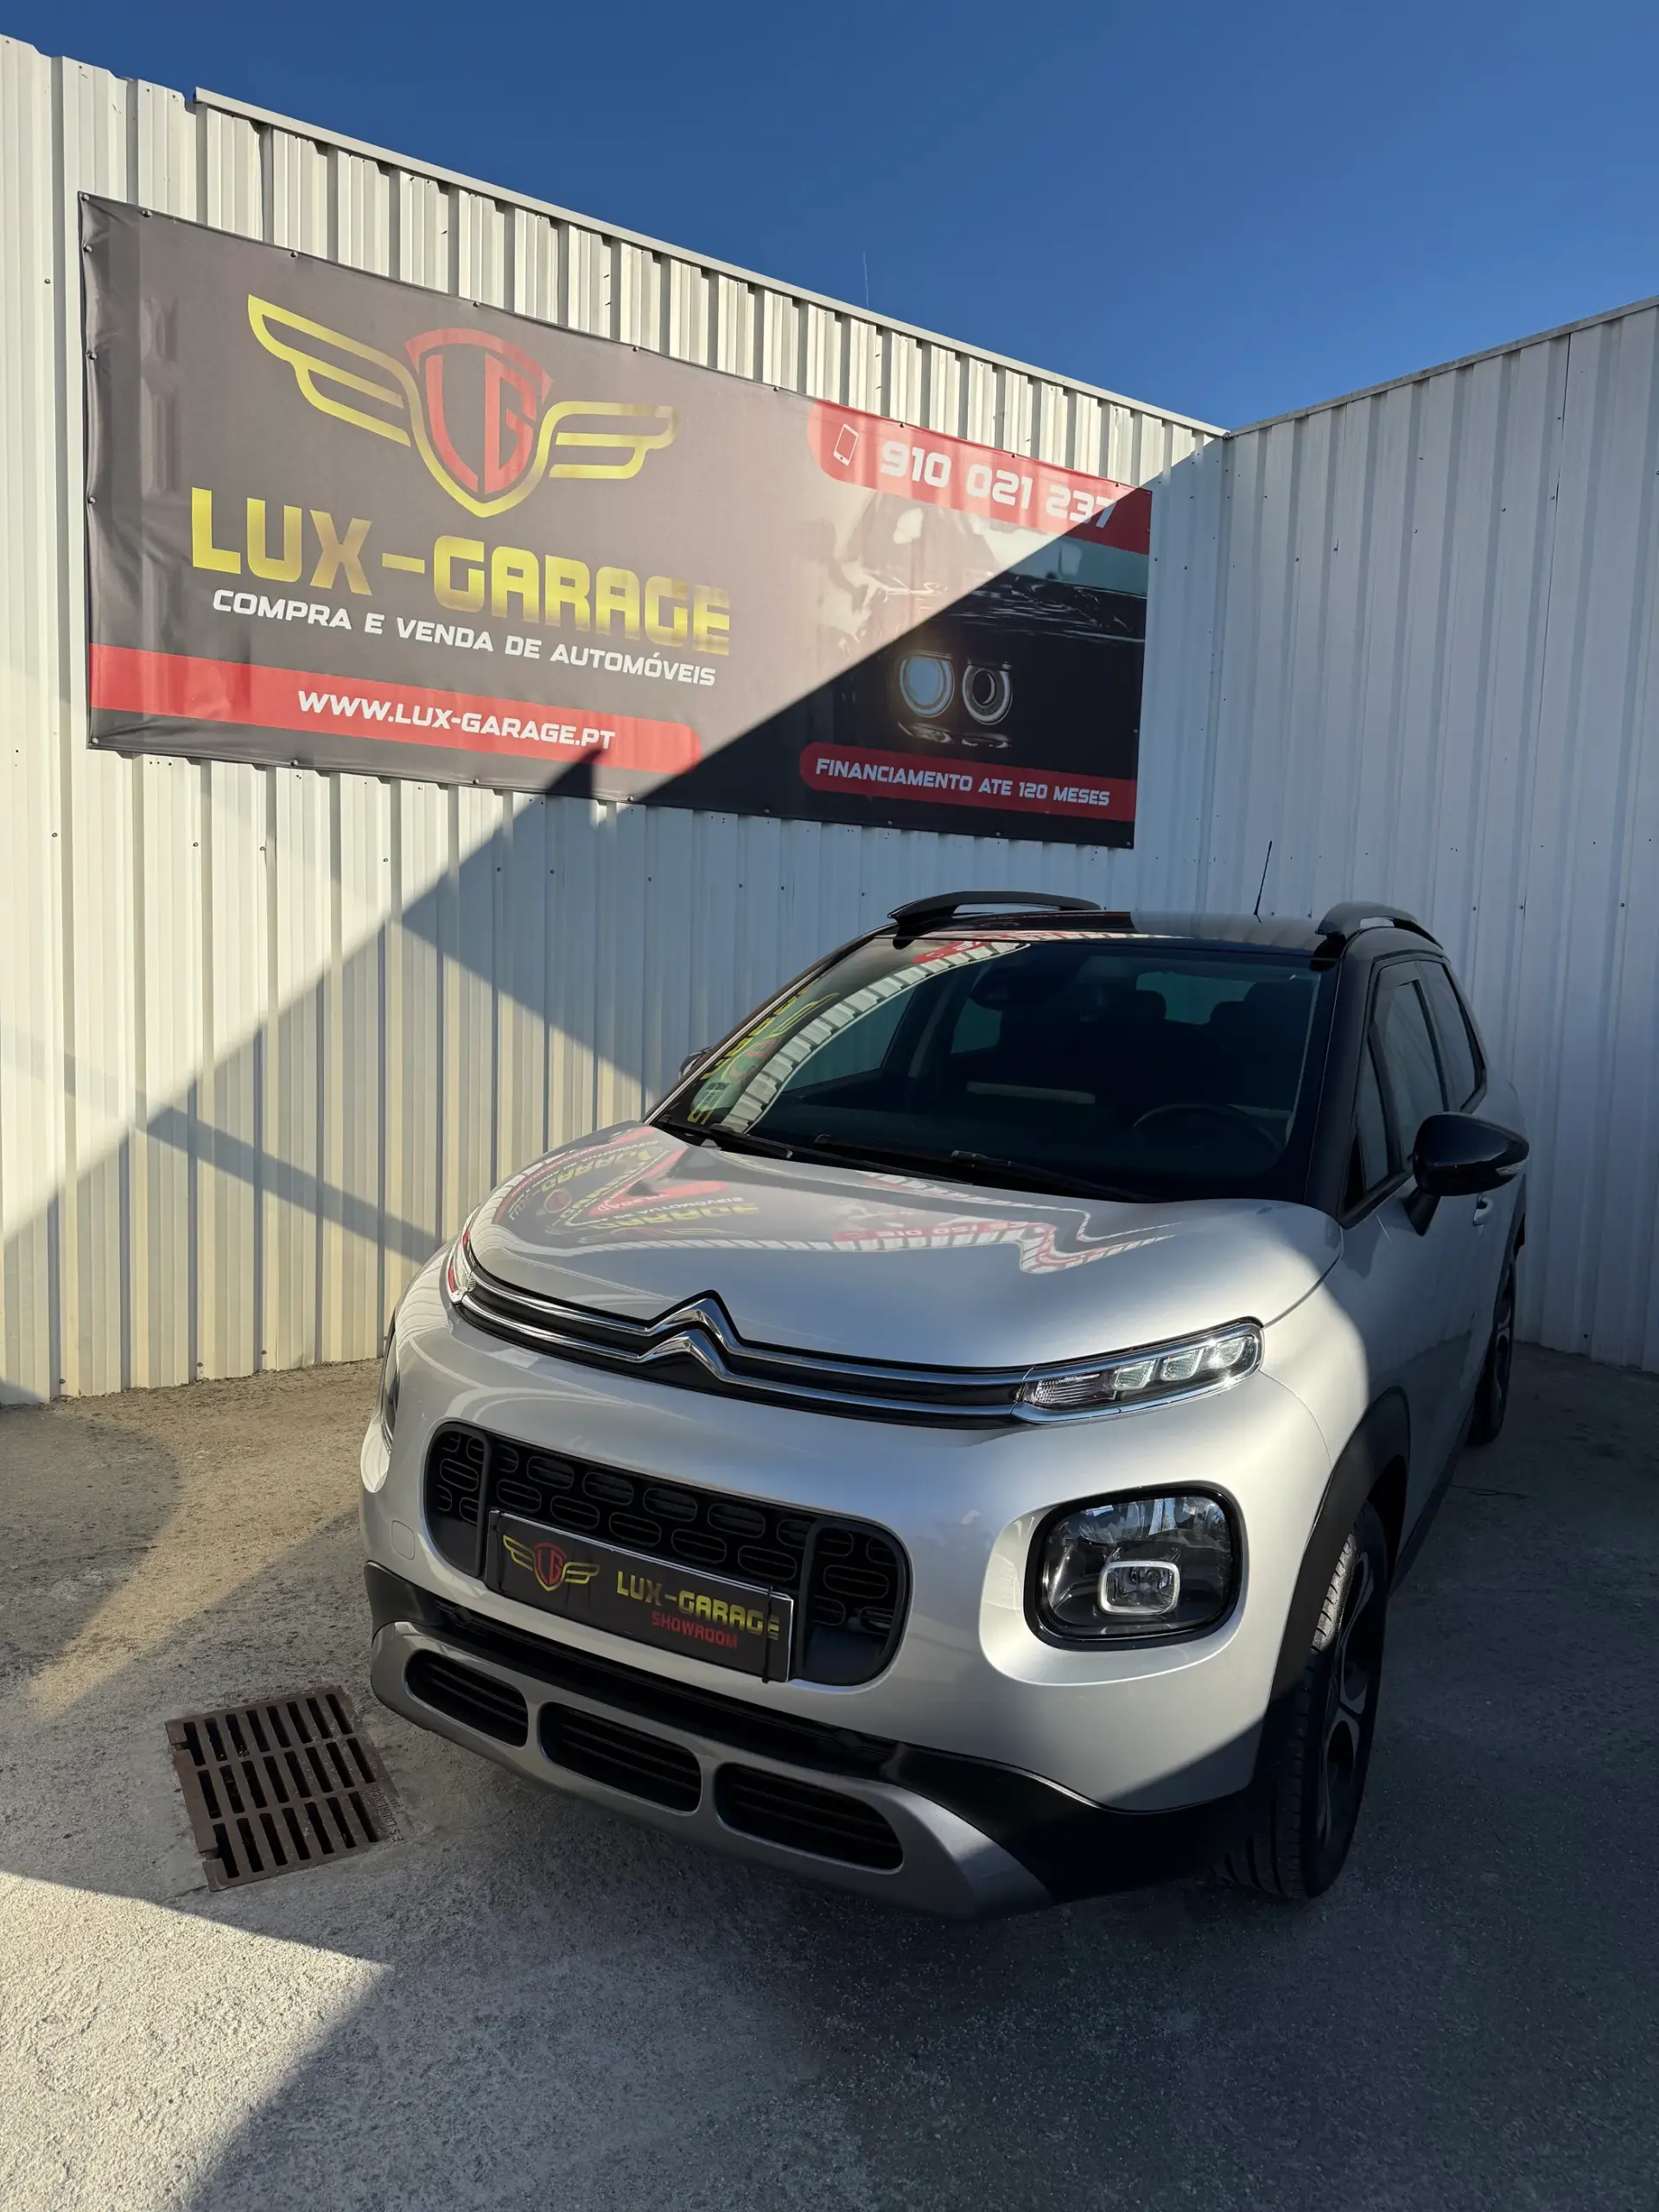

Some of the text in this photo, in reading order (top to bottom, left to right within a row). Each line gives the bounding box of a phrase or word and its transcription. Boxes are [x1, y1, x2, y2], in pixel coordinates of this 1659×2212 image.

[880, 441, 1116, 528] 910 021 237
[213, 589, 716, 686] COMPRA E VENDA DE AUTOMÓVEIS
[298, 690, 616, 749] WWW.LUX-GARAGE.PT
[816, 758, 1110, 806] FINANCIAMENTO ATE 120 MESES
[652, 1610, 738, 1649] SHOWROOM
